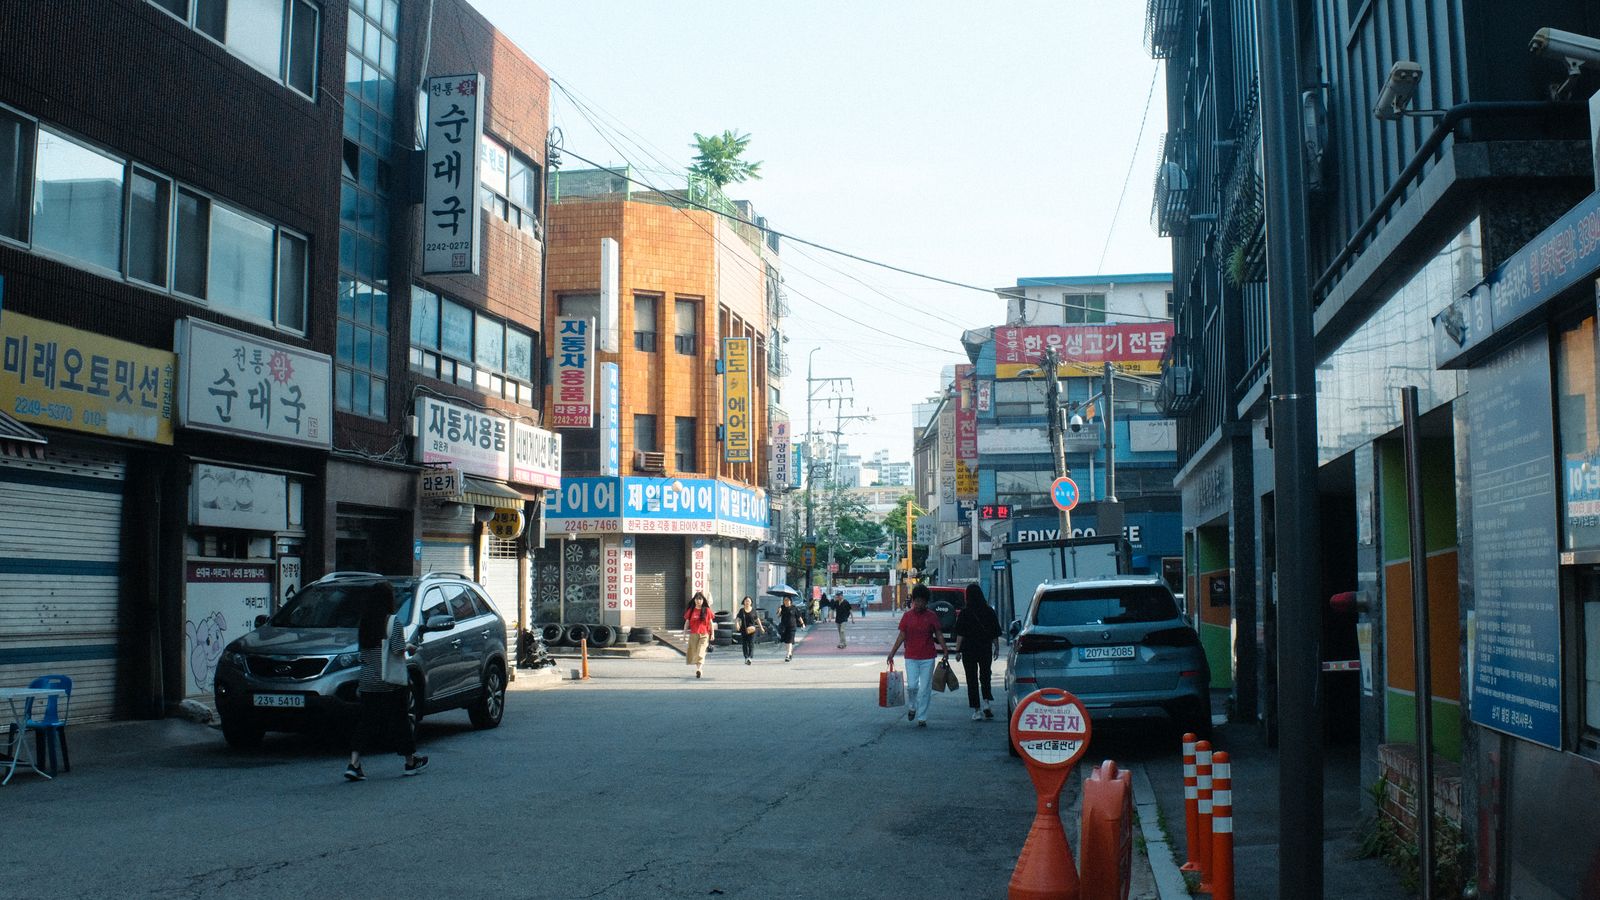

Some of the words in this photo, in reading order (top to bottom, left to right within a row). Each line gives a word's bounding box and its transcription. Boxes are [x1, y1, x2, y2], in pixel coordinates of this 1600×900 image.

[431, 82, 453, 97] 전통
[462, 82, 474, 96] 왕
[432, 103, 470, 237] 순대국
[426, 241, 470, 252] 2242-0272
[727, 341, 747, 374] 만도
[1023, 332, 1124, 358] 한우생고기
[1128, 331, 1167, 353] 전문
[2, 335, 161, 410] 미래오토밋션
[231, 346, 265, 378] 전통
[273, 353, 289, 378] 왕
[558, 319, 588, 403] 자동차용품
[14, 396, 73, 423] 2249-5370
[207, 367, 307, 436] 순대국
[554, 405, 590, 416] 라온카
[428, 403, 507, 453] 자동차용품
[727, 396, 748, 448] 에어콘
[433, 439, 449, 454] 라온카
[423, 474, 455, 492] 라온카
[545, 481, 616, 513] 타이어
[627, 482, 713, 514] 제일타이어
[719, 485, 769, 524] 제일타이어
[627, 520, 641, 532] 한국
[643, 520, 655, 532] 금호
[657, 520, 671, 532] 각종
[699, 520, 713, 534] 전문
[1017, 528, 1061, 543] EDIY
[623, 550, 633, 608] 제일타이어
[935, 605, 949, 613] Jeep
[1110, 645, 1134, 657] 2085
[277, 696, 301, 706] 5410
[1024, 713, 1080, 732] 주차금지
